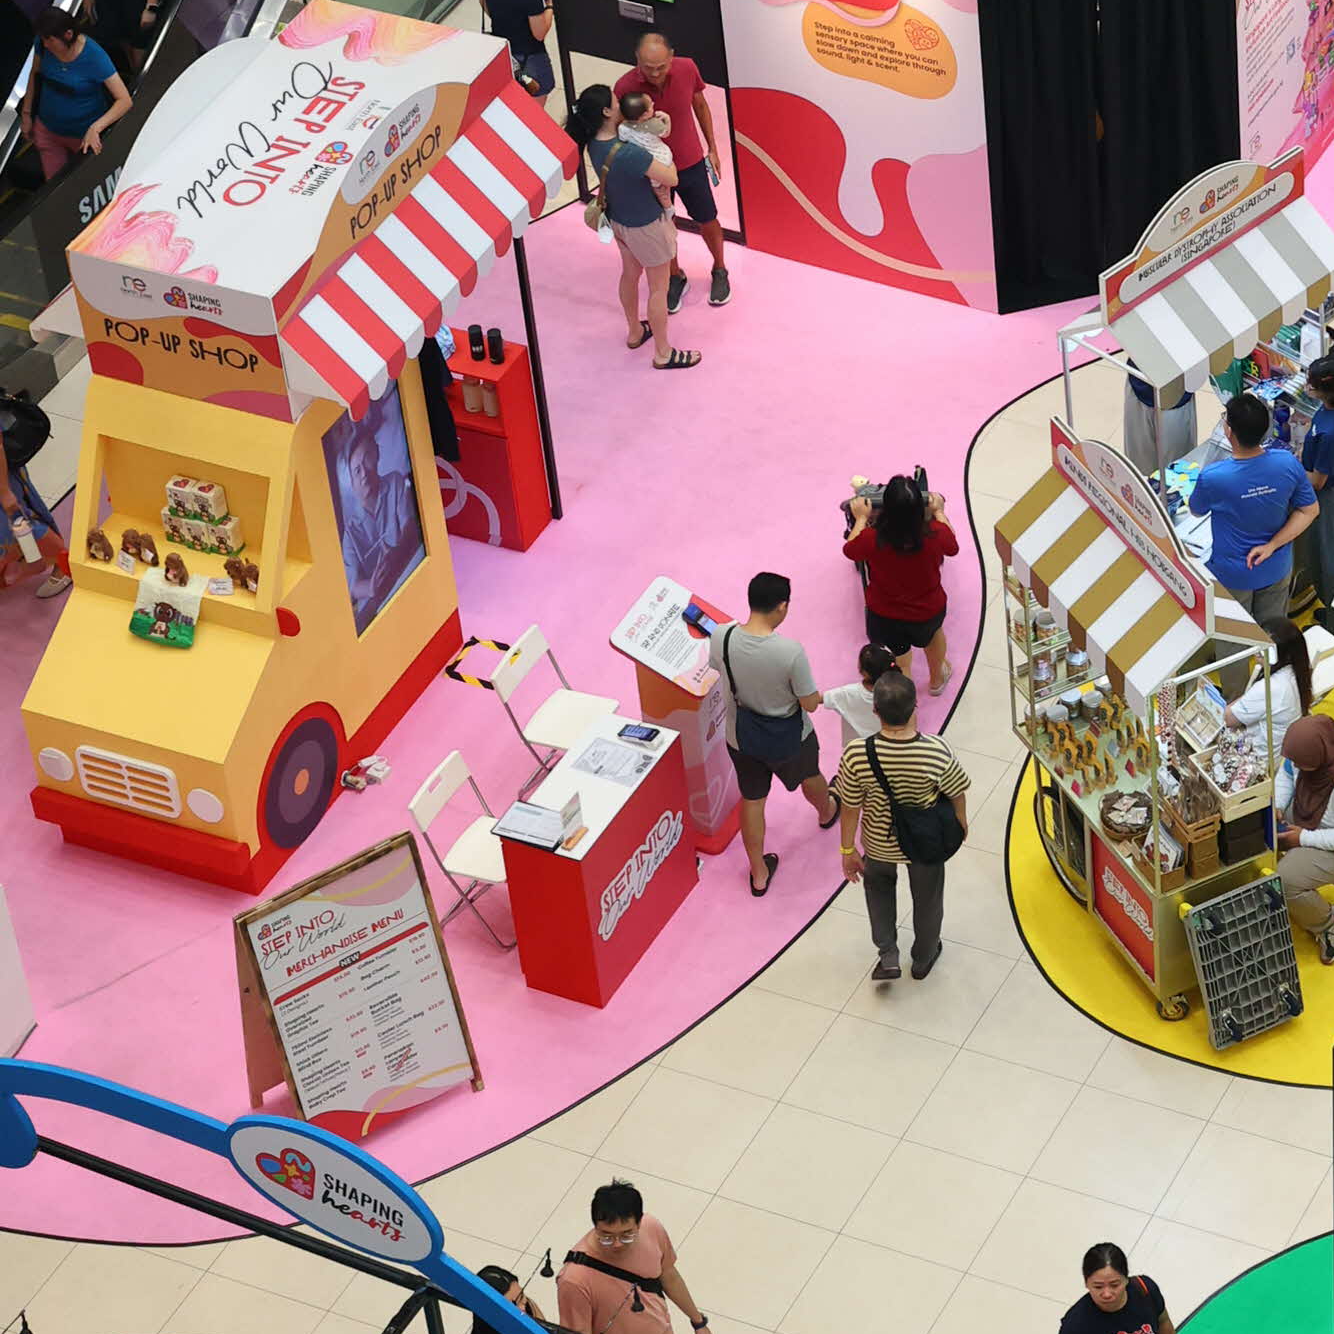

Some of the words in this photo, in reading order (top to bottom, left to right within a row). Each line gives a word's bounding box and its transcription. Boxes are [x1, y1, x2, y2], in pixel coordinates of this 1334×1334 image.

[813, 21, 835, 34] Step
[834, 25, 852, 37] into
[859, 33, 896, 49] calming
[815, 30, 849, 45] sensory
[849, 38, 877, 51] space
[877, 43, 904, 57] where
[904, 52, 921, 64] you
[921, 56, 939, 66] can
[815, 38, 836, 50] slow
[836, 42, 860, 54] down
[860, 48, 879, 59] and
[878, 53, 912, 68] explore
[911, 60, 947, 76] through
[816, 47, 845, 60] sound,
[845, 53, 866, 66] light
[874, 61, 901, 73] scent.
[269, 59, 334, 122] Our
[300, 75, 367, 135] STEP
[176, 120, 273, 219] World
[221, 134, 312, 208] INTO
[288, 162, 325, 196] hearts
[301, 166, 337, 198] SHAPING
[349, 175, 397, 240] POP-UP
[400, 124, 444, 187] SHOP
[1216, 175, 1240, 193] SHAPING
[1137, 252, 1173, 282] MUSCULAR
[1173, 222, 1219, 258] DYSTROPHY
[1220, 183, 1277, 227] ASSOCIATION
[1180, 220, 1236, 265] (SINGAPORE)
[187, 290, 222, 309] SHAPING
[188, 300, 224, 317] hearts
[104, 317, 181, 357] POP-UP
[189, 338, 260, 374] SHOP
[602, 863, 633, 915] STEP
[634, 815, 671, 871] INTO
[259, 945, 295, 971] Our
[298, 912, 346, 954] World
[261, 930, 292, 957] STEP
[294, 909, 335, 939] INTO
[285, 927, 369, 978] MERCHANDISE
[371, 908, 405, 934] MENU
[339, 951, 361, 967] NEW
[319, 1188, 408, 1243] hearts
[322, 1172, 405, 1229] SHAPING
